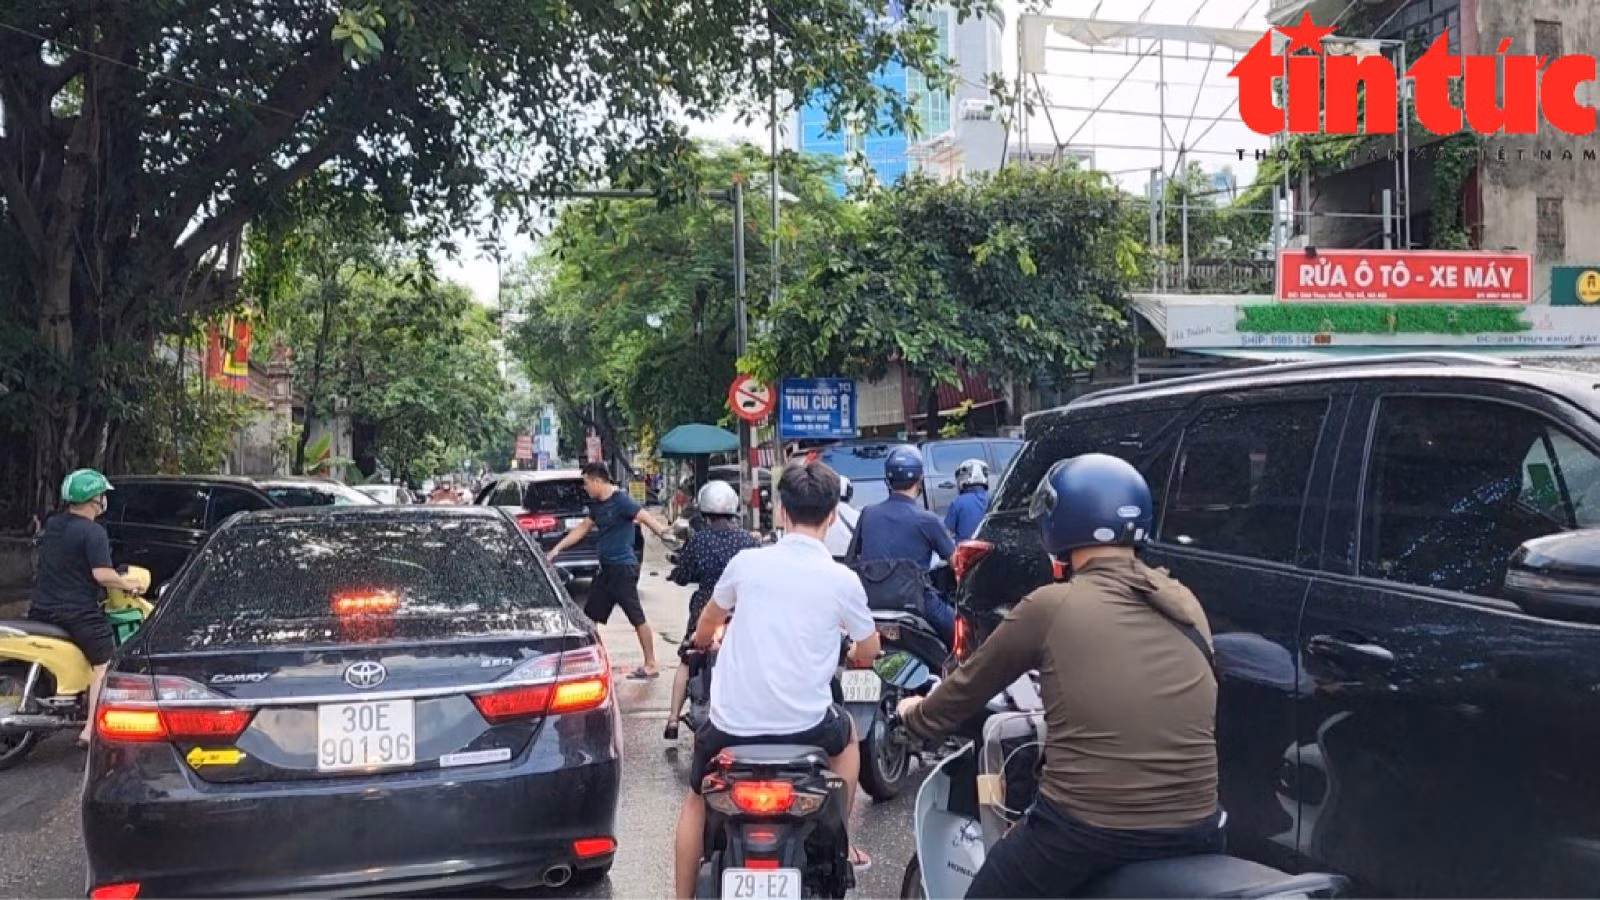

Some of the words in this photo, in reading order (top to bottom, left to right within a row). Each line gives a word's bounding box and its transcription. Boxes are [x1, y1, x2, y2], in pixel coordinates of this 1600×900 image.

[1300, 257, 1348, 287] RỬA
[1354, 259, 1374, 287] Ô
[1380, 260, 1411, 287] TÔ
[1429, 264, 1458, 288] XE
[1464, 261, 1514, 288] MÁY
[784, 395, 809, 410] THU
[342, 703, 391, 732] 30E
[734, 874, 788, 898] 29-E2
